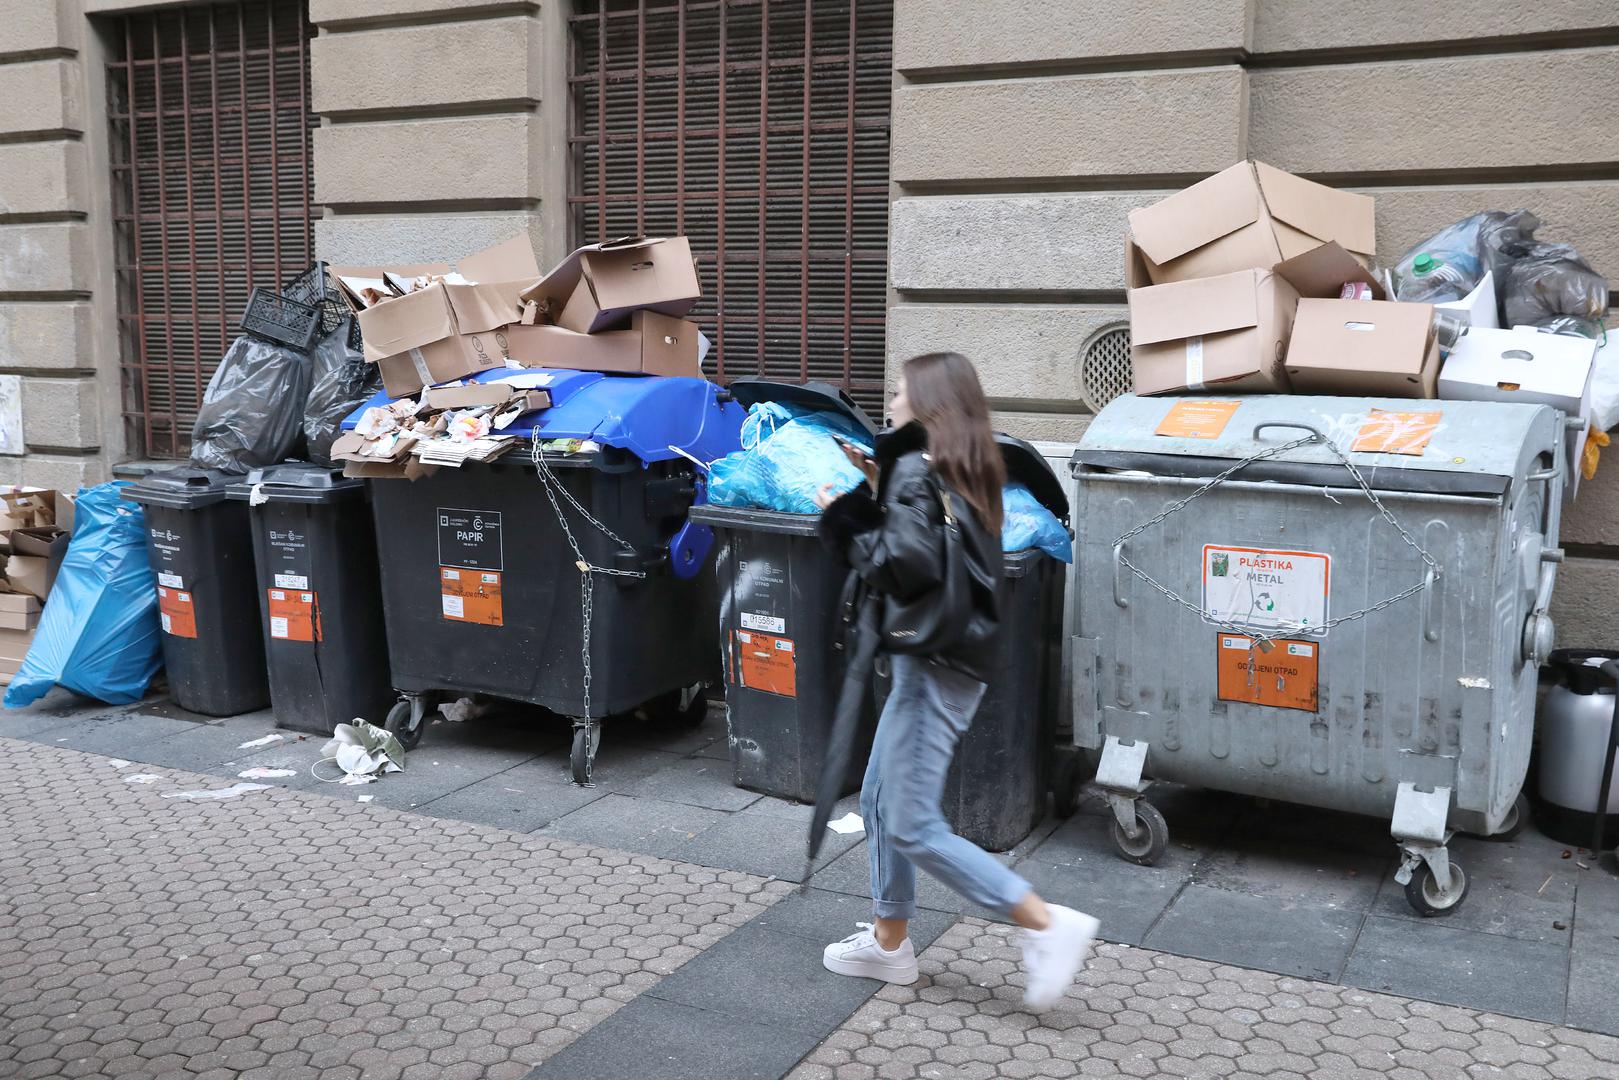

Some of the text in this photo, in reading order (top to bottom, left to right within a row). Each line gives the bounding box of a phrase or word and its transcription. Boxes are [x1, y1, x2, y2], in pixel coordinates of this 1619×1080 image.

[457, 531, 484, 542] PAPIR
[1239, 557, 1293, 570] PLASTIKA
[1246, 572, 1284, 584] METAL
[1237, 662, 1298, 676] ODOJENI OTPAD
